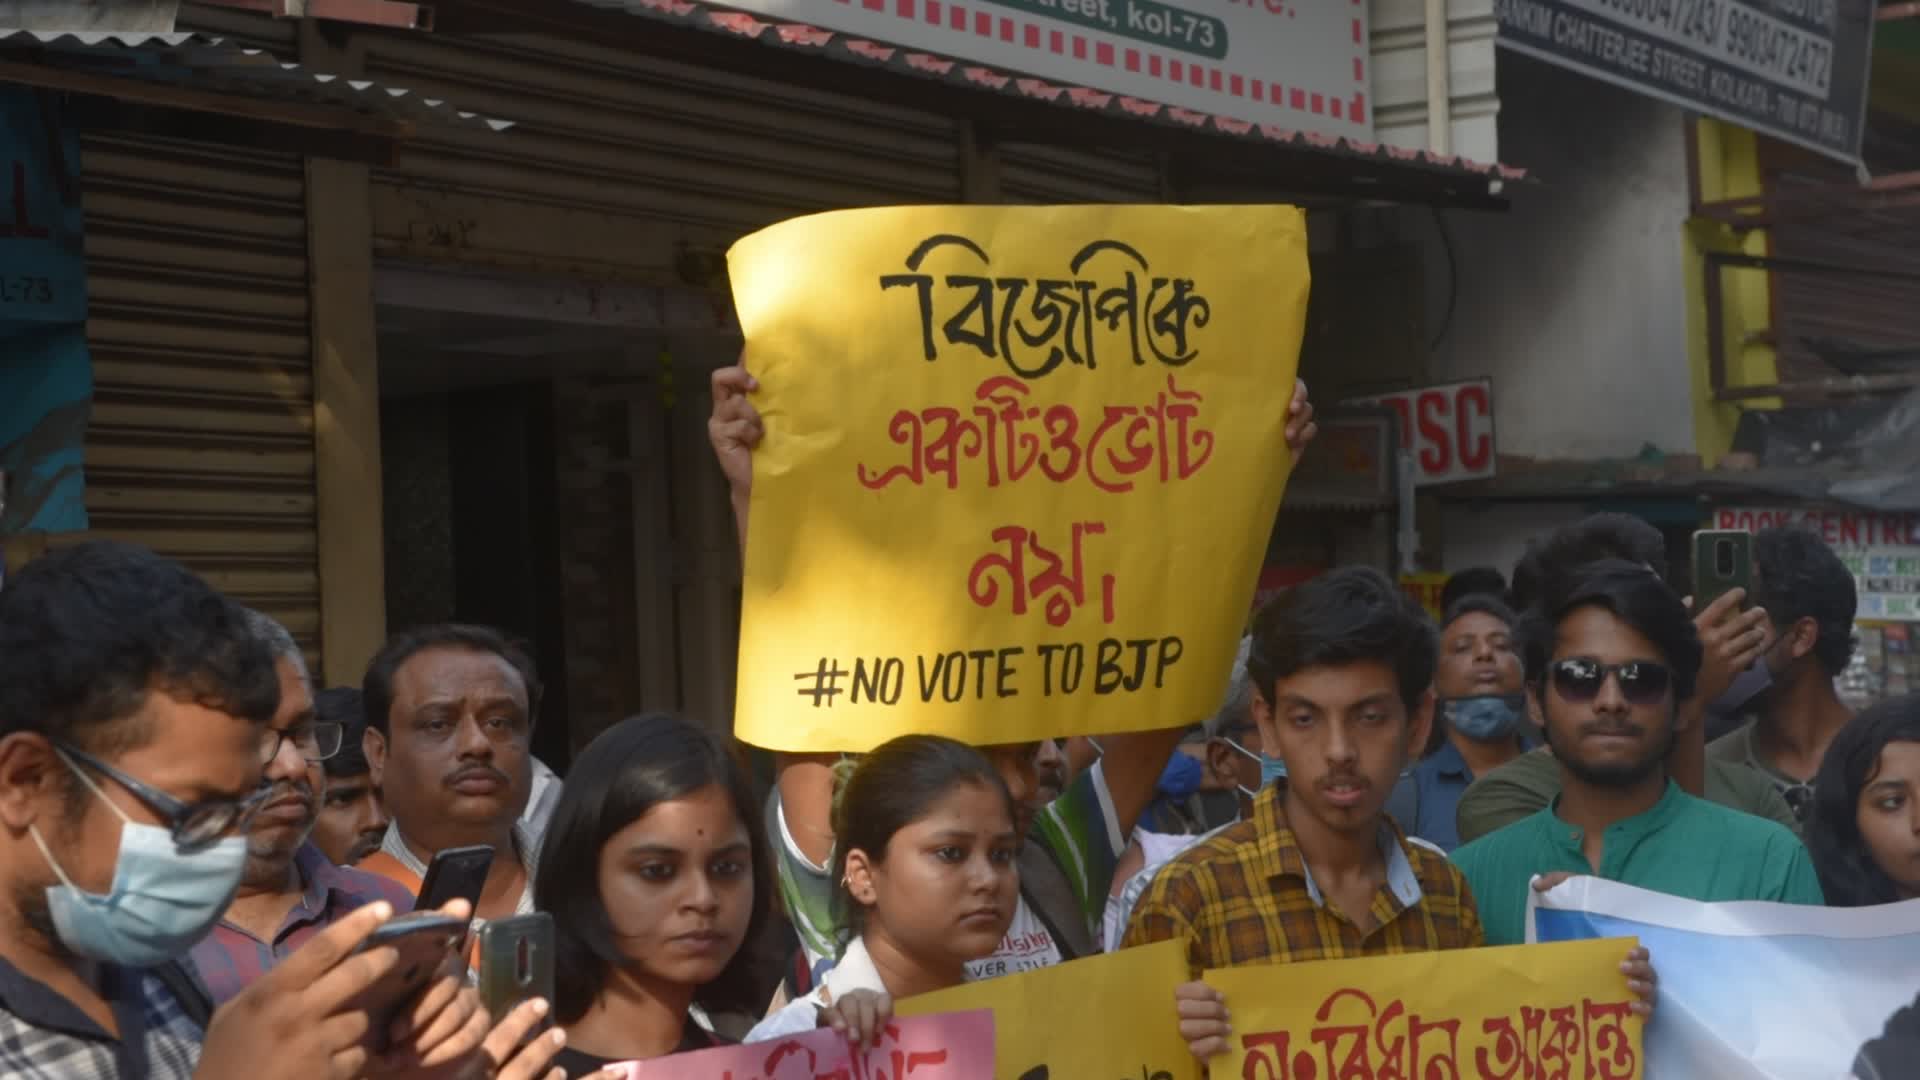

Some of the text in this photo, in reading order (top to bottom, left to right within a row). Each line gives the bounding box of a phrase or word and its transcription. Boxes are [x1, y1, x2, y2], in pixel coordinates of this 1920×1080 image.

[1022, 0, 1117, 27] eet,
[1128, 3, 1216, 48] kol-73
[1554, 12, 1650, 74] CHATTERJEE
[1710, 68, 1768, 115] KOLKATA
[880, 234, 1210, 378] বিজেপিকে
[1086, 373, 1214, 492] ভোট
[794, 636, 1183, 708] #NO VOTE TO BJP
